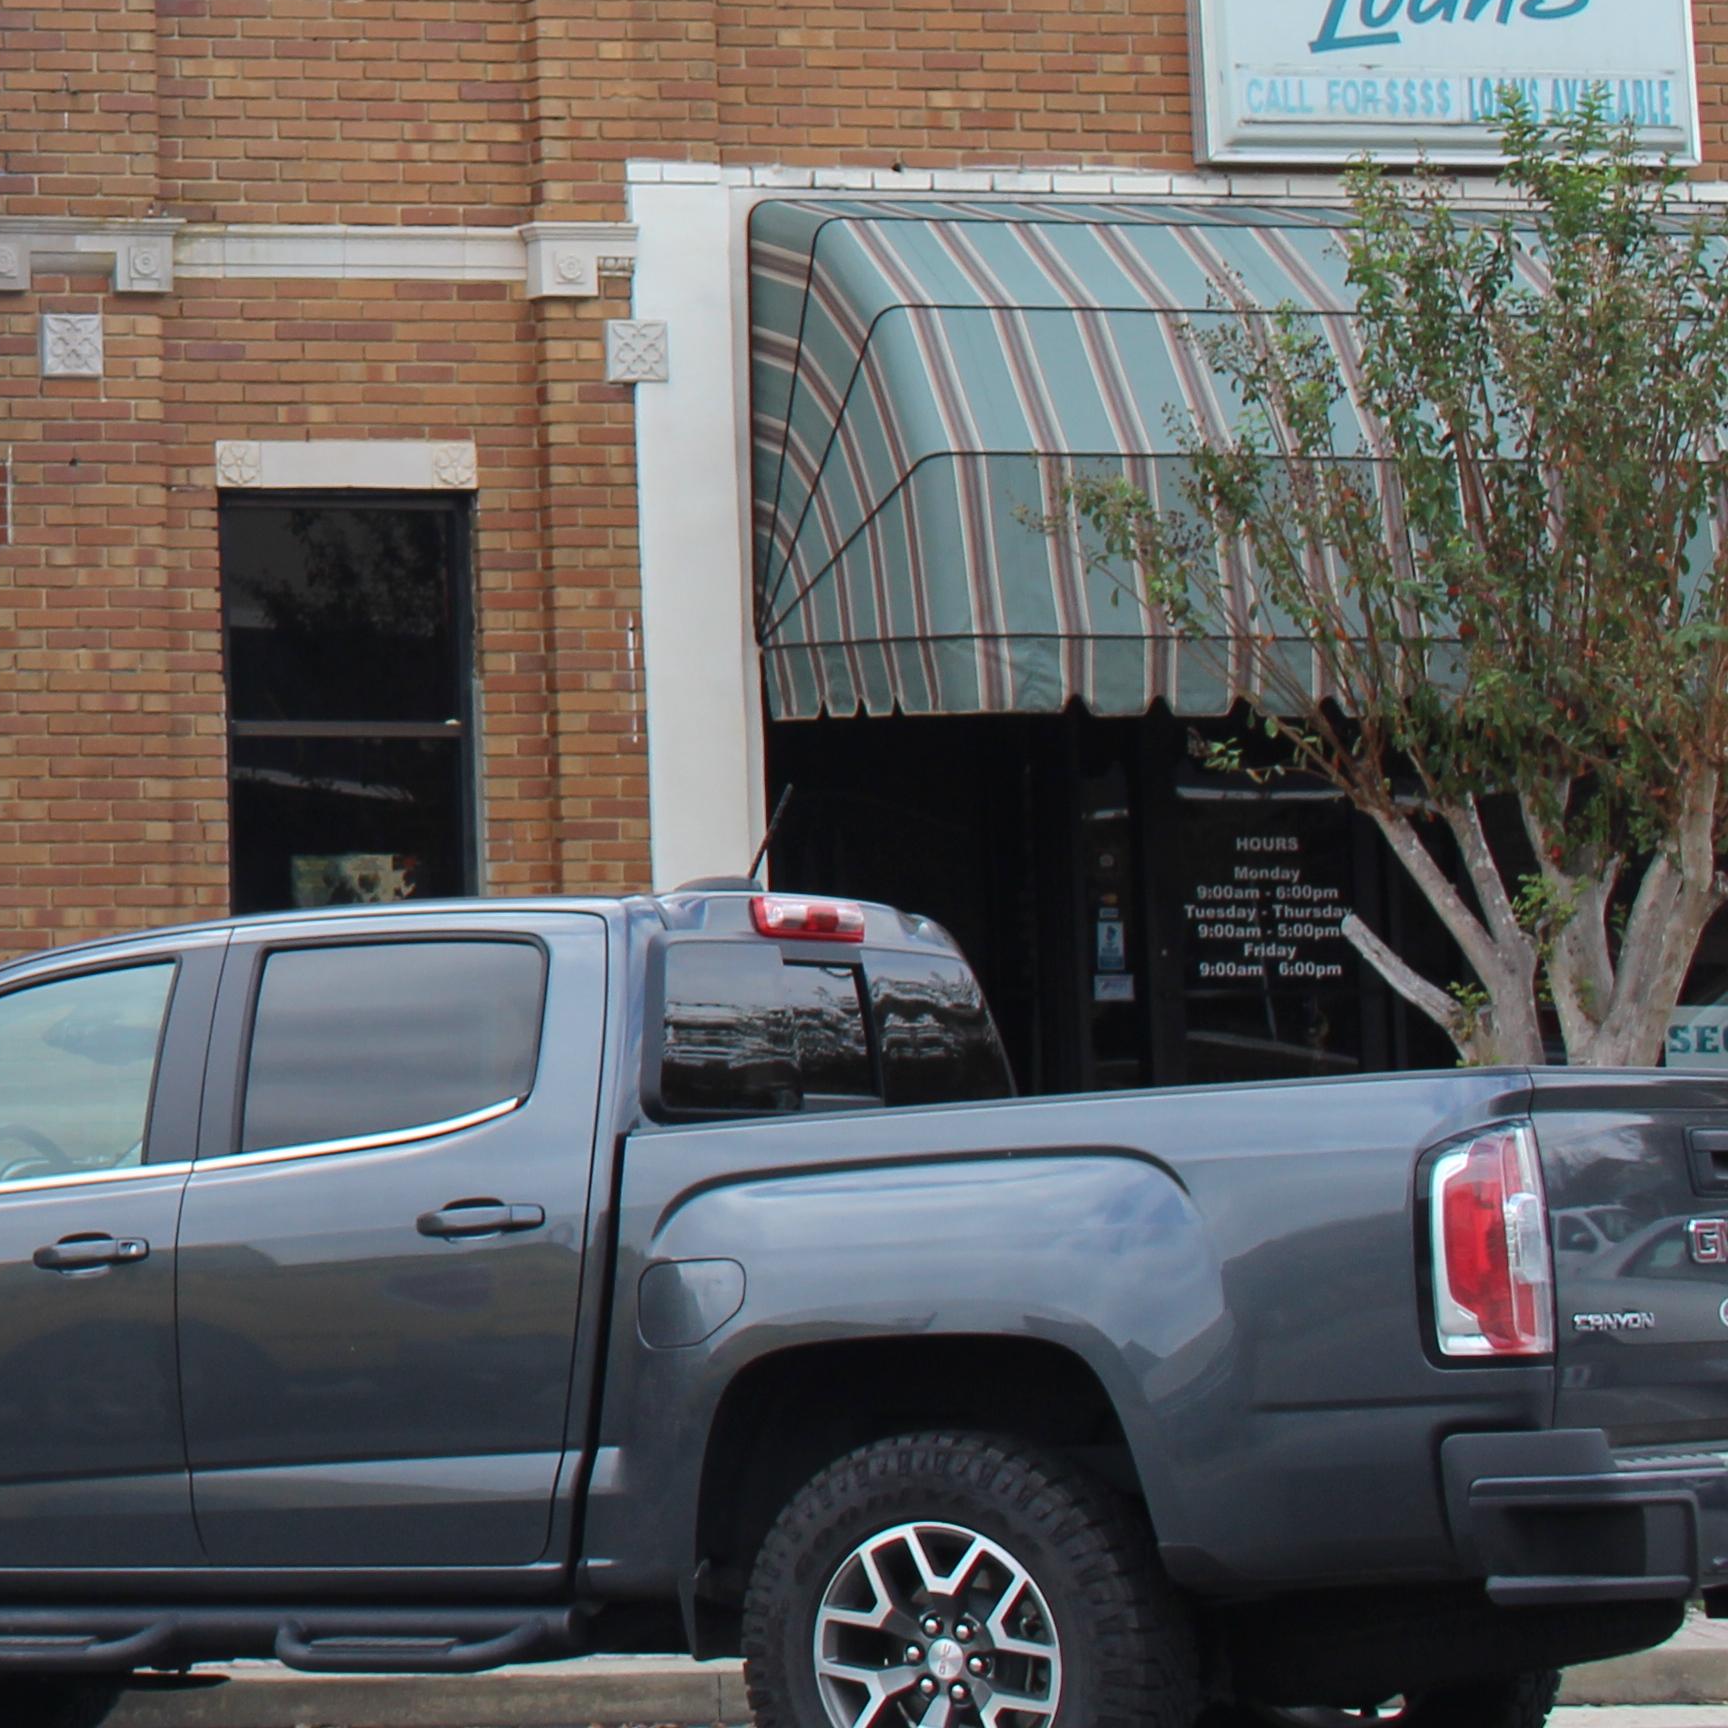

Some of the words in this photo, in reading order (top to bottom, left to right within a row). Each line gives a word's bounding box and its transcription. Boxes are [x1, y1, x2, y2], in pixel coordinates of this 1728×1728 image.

[1245, 76, 1313, 115] CALL
[1236, 837, 1299, 851] HOURS
[1234, 866, 1300, 883] Monday
[1197, 885, 1260, 900] 9:00am
[1276, 885, 1339, 902] 6:00pm
[1184, 904, 1257, 922] Tuesday
[1198, 924, 1262, 938] 9:00am
[1277, 924, 1341, 941] 5:00pm
[1244, 943, 1296, 960] Friday
[1199, 962, 1263, 977] 9:00am
[1278, 962, 1342, 980] 6:00pm
[1574, 1313, 1655, 1331] CANYON
